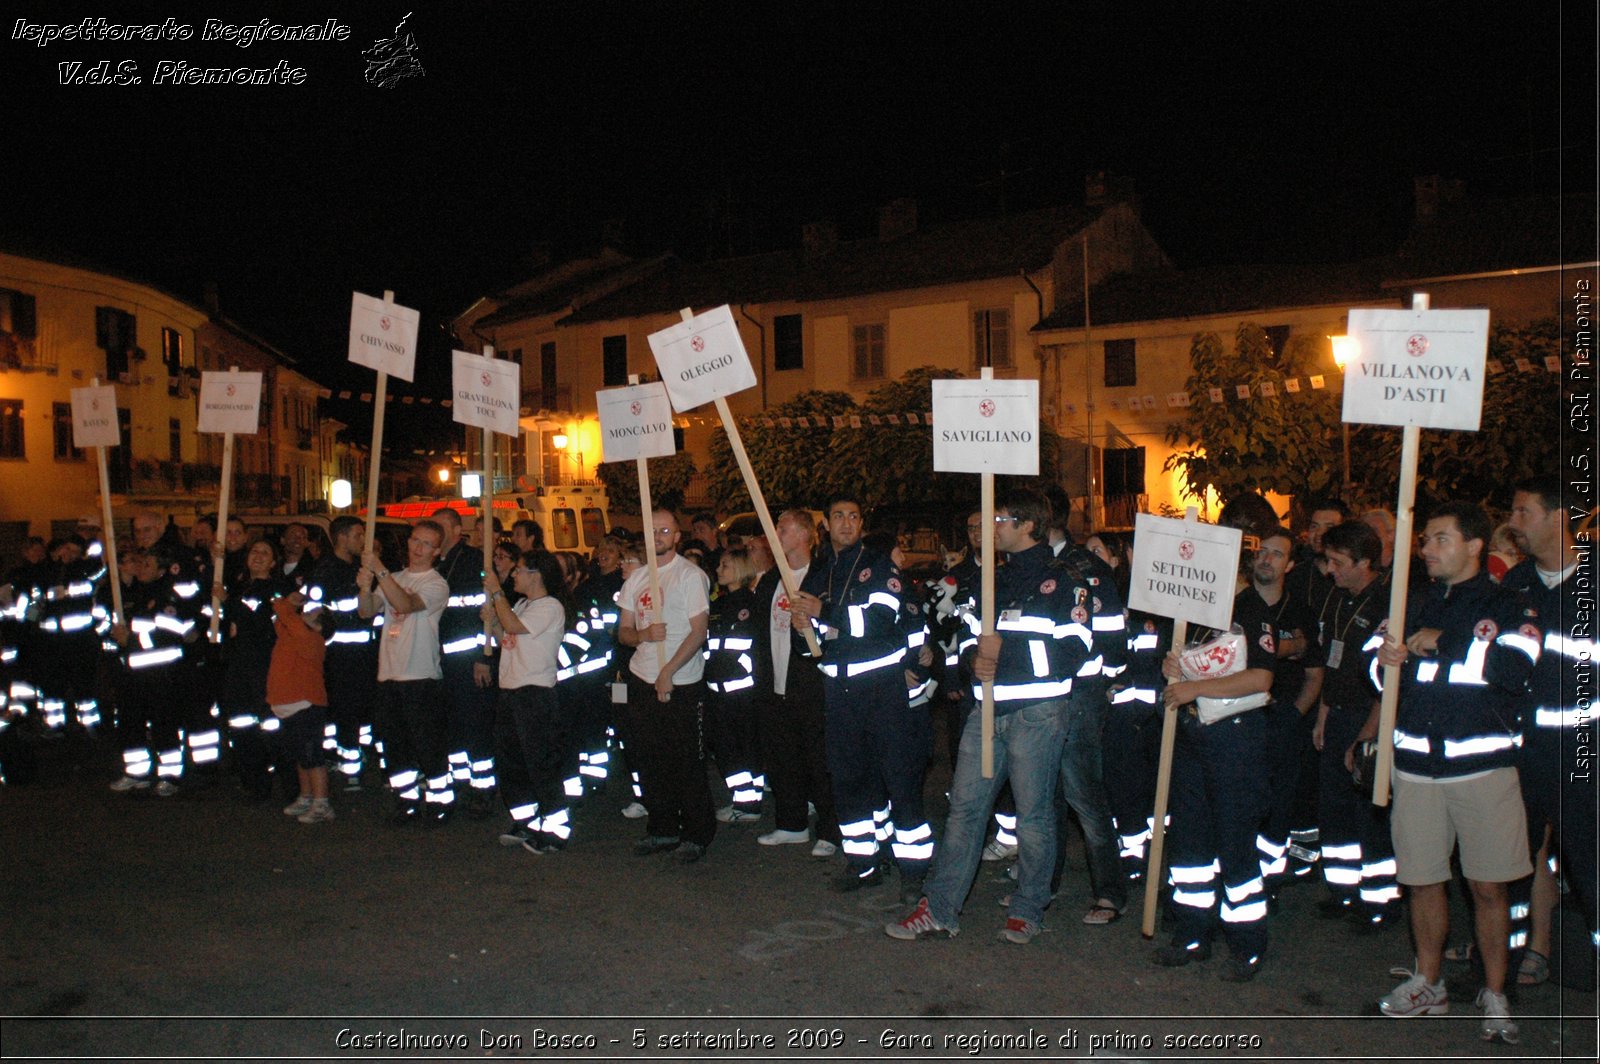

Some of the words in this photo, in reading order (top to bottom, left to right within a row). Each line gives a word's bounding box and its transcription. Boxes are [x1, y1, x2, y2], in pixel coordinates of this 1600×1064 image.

[360, 333, 405, 356] CHIVASSO
[680, 353, 733, 382] OLEGGIO
[1361, 362, 1471, 382] VILLANOVA
[458, 390, 514, 411] GRAVELLONA
[1383, 386, 1446, 403] D'ASTI
[205, 403, 254, 411] BORGOMANERO
[476, 406, 497, 419] TOCE
[609, 422, 667, 440] MONCALVO
[942, 430, 1032, 443] SAVIGLIANO
[1151, 560, 1216, 584] SETTIMO
[1146, 578, 1217, 604] TORINESE
